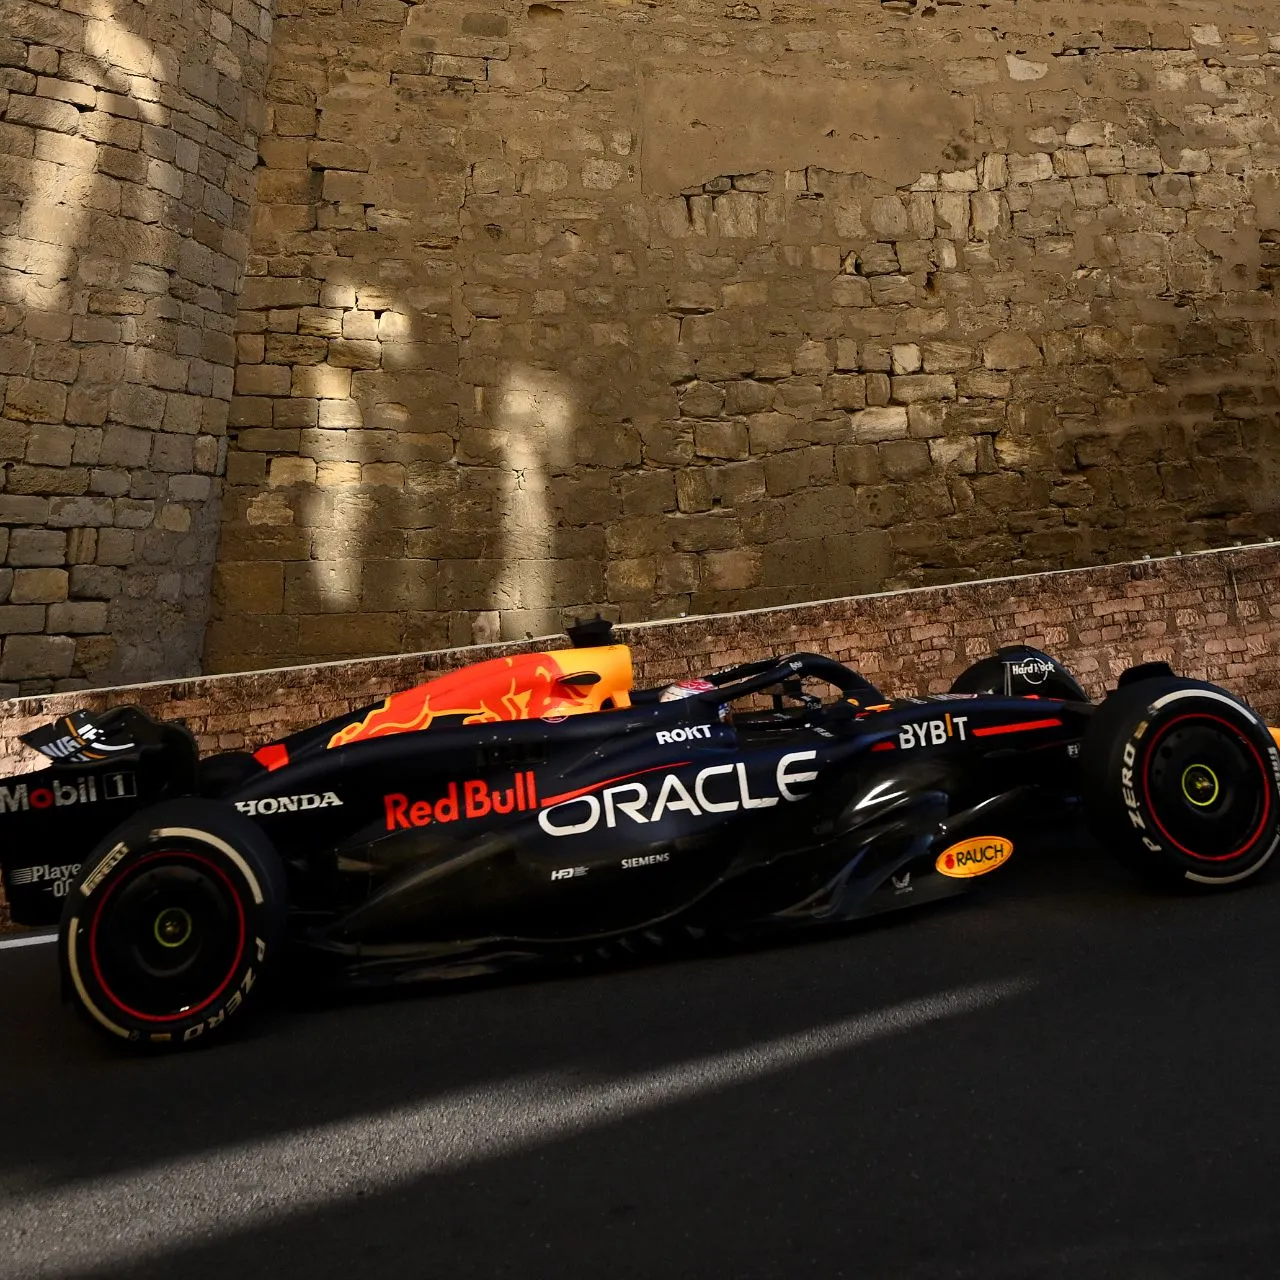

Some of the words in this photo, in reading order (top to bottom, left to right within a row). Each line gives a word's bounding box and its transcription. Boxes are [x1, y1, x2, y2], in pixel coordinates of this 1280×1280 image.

[655, 724, 712, 745] ROKT
[898, 713, 968, 749] BYBIT
[112, 774, 125, 796] 1
[538, 750, 820, 837] ORACLE
[1121, 743, 1146, 830] ZERO
[235, 791, 344, 816] HONDA
[621, 852, 670, 869] SIEMENS
[955, 844, 1004, 867] RAUCH
[31, 863, 81, 882] Playe
[183, 967, 257, 1041] ZERO
